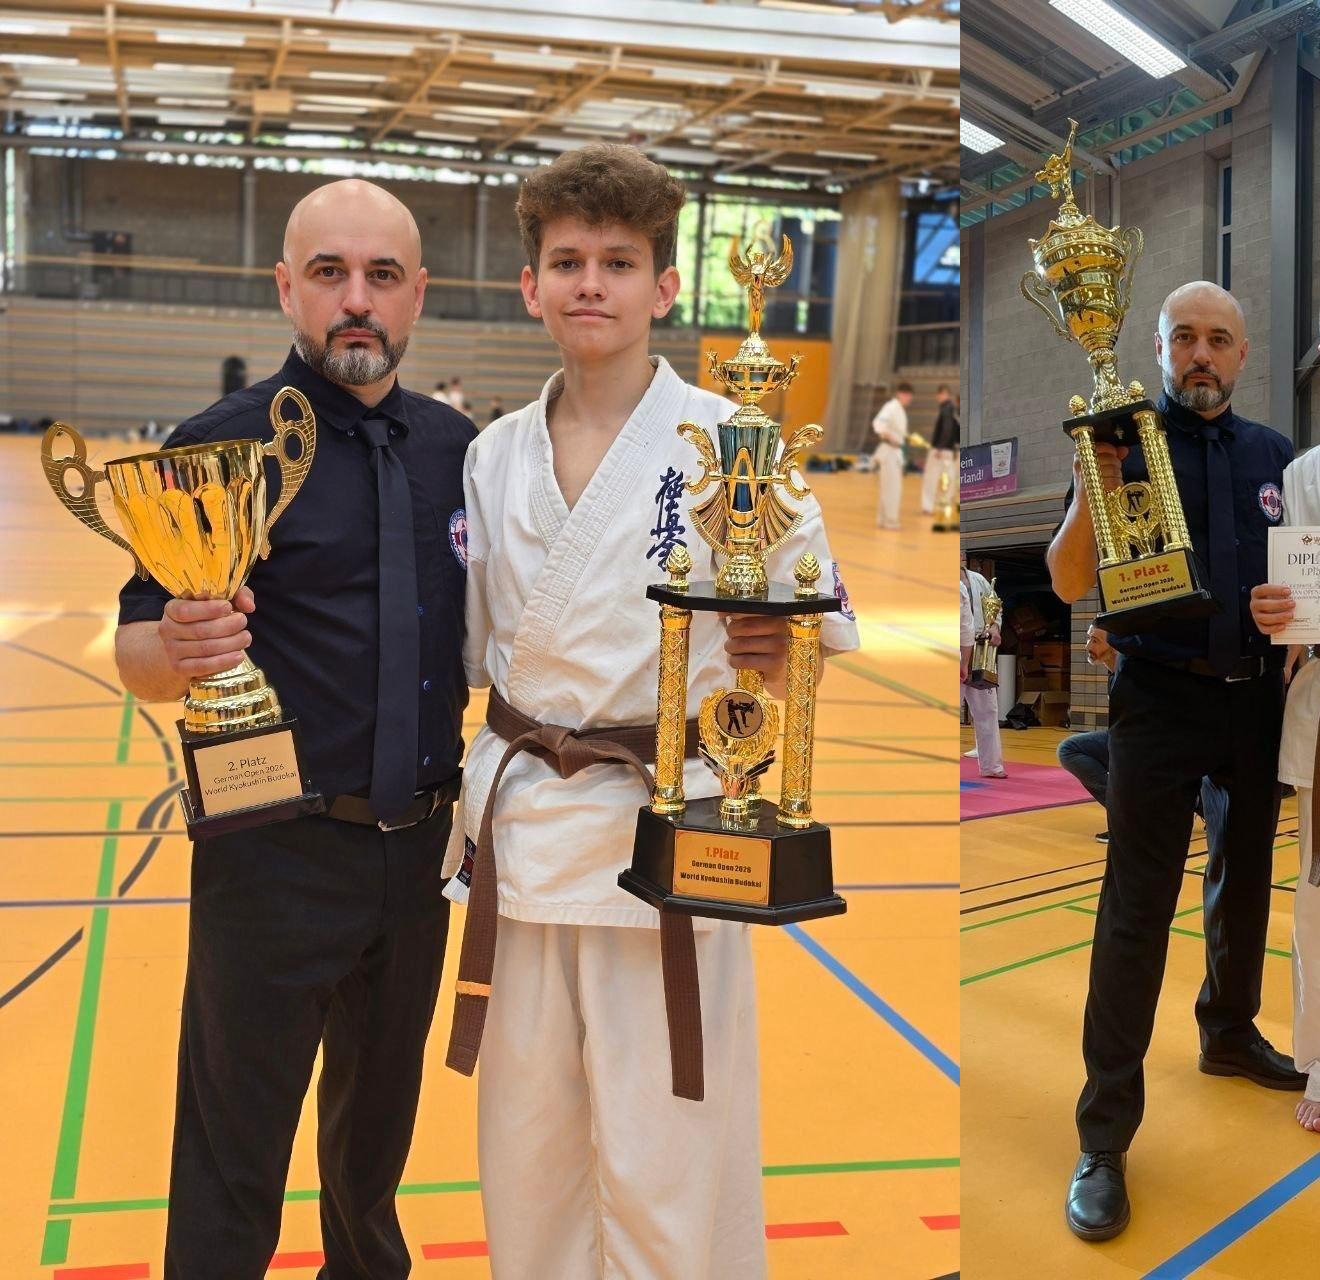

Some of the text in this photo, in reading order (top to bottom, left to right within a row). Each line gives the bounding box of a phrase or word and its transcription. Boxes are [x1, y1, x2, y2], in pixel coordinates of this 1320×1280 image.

[1118, 563, 1170, 582] 1. Platz
[1111, 582, 1186, 605] World Kyokushin Budokai
[1119, 585, 1143, 594] German
[1143, 581, 1160, 589] Open
[228, 756, 267, 772] 2. Platz
[213, 763, 285, 784] German Open 2026
[204, 771, 297, 796] World Kyokushin Budokai
[691, 860, 752, 874] German Open 2026
[680, 872, 762, 888] World Kyokushin Budokai
